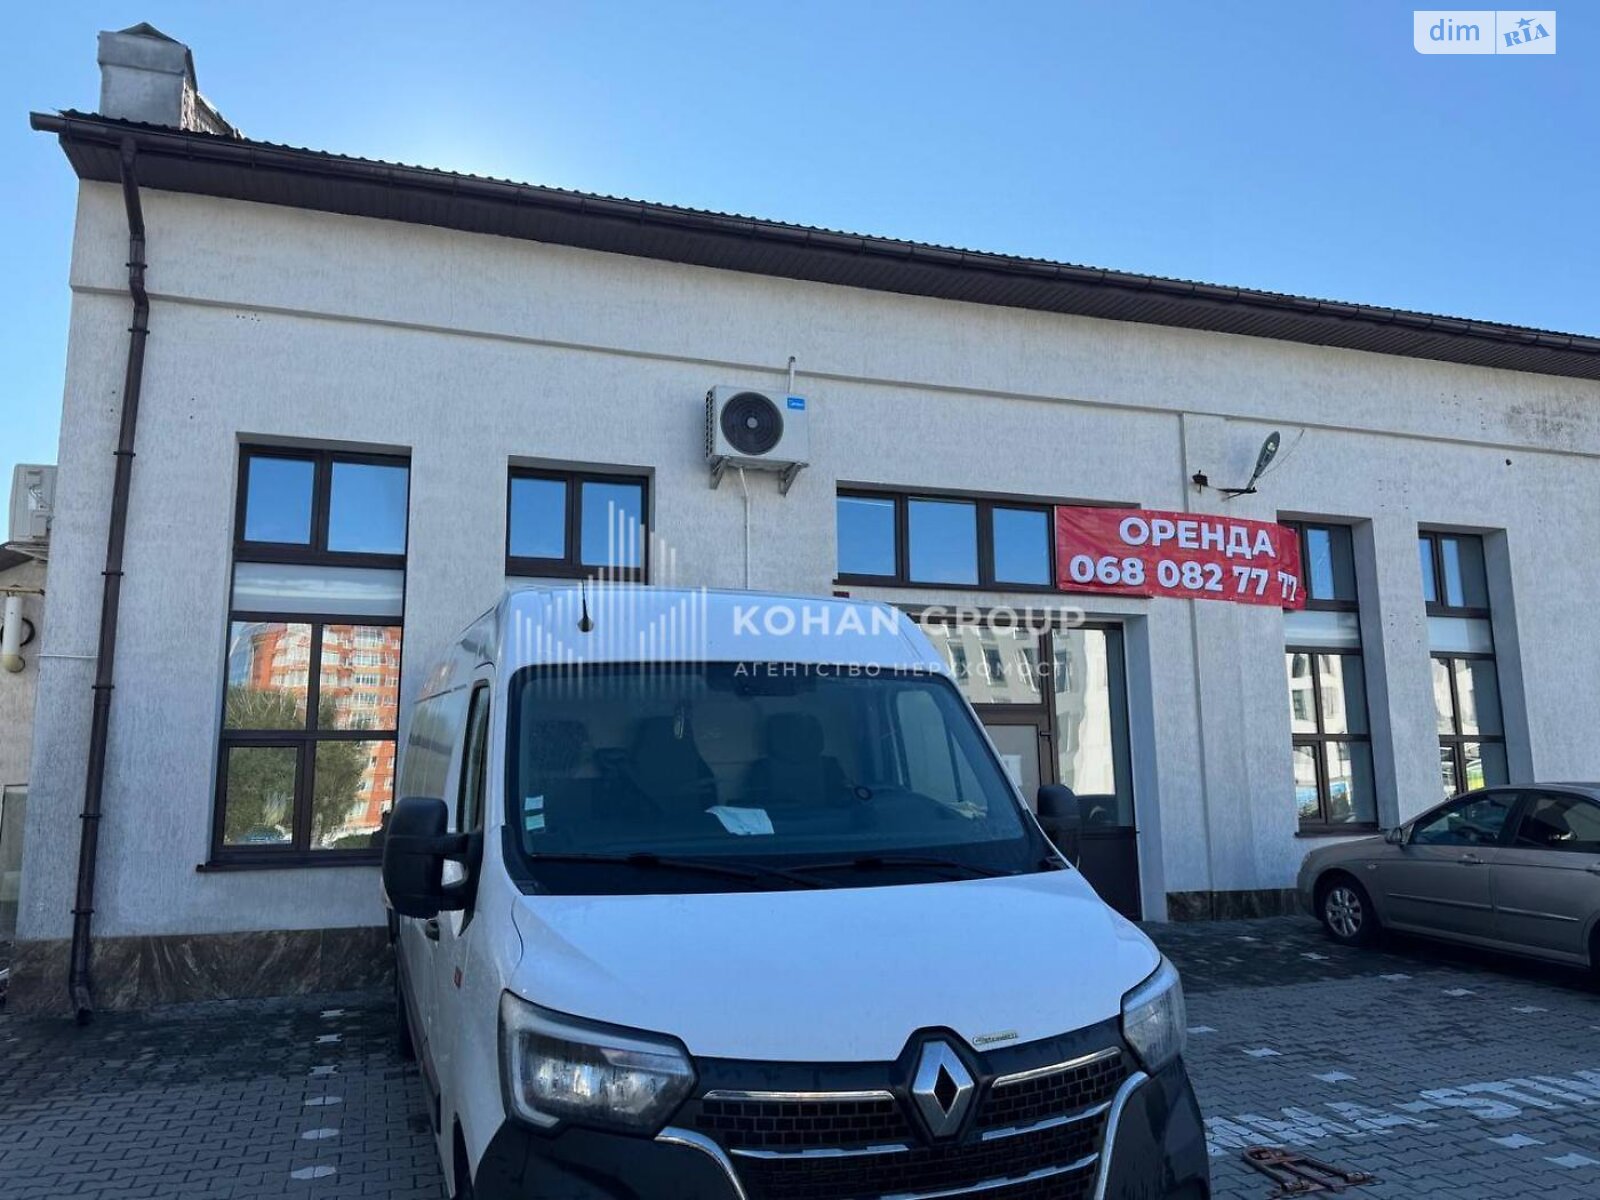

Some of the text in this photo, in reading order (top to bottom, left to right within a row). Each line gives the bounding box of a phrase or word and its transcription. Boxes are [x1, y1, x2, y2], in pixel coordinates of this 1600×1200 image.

[1119, 516, 1277, 559] ОРЕНДА
[1069, 554, 1298, 601] 068 082 77 77
